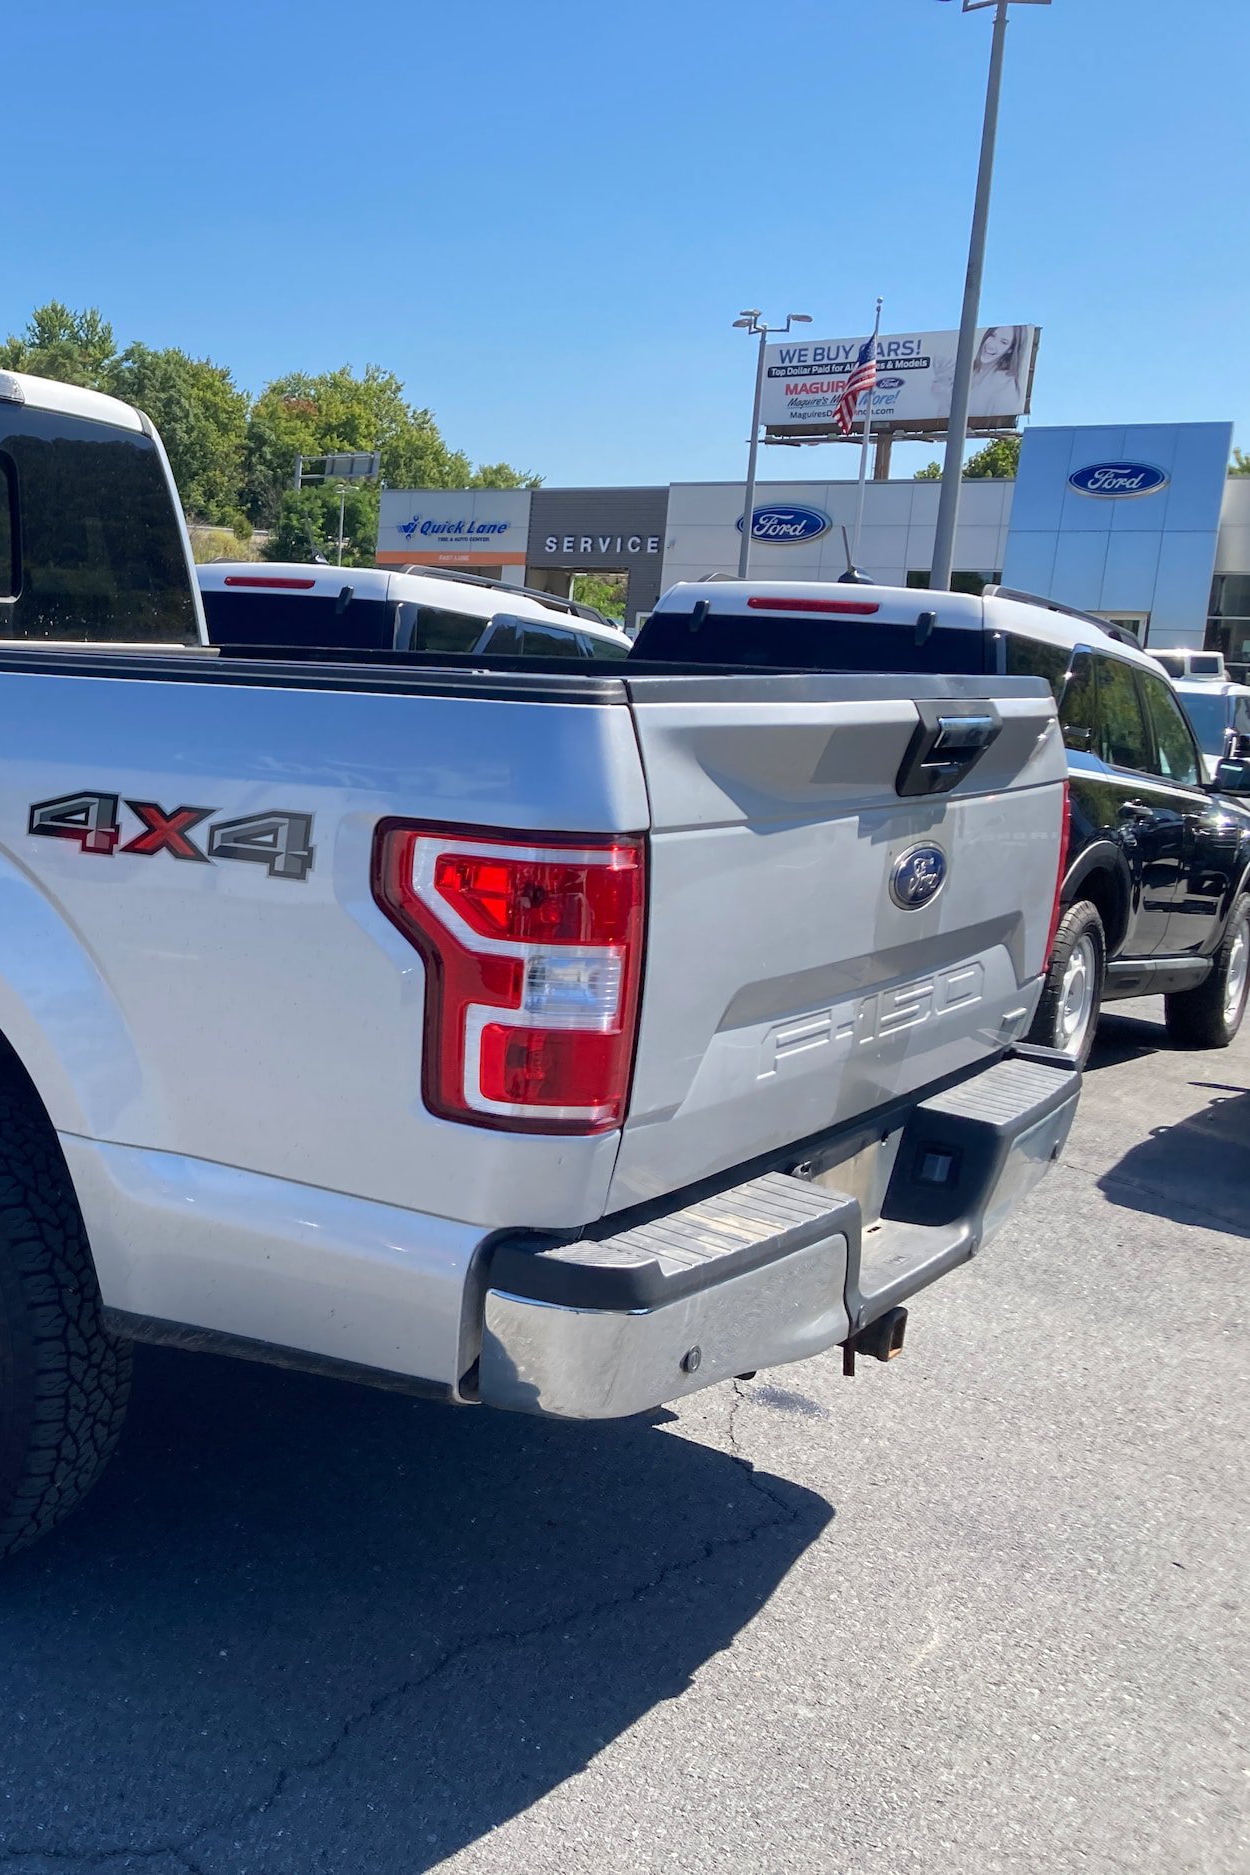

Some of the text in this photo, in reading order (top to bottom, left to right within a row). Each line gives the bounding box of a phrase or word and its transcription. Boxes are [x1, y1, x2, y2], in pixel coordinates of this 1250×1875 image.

[779, 348, 808, 364] WE
[813, 344, 855, 362] BUY
[771, 368, 786, 377] Top
[787, 366, 811, 375] Dollar
[812, 365, 830, 373] Paid
[831, 364, 843, 372] for
[895, 359, 927, 369] Models
[785, 380, 846, 396] MAGUIR
[879, 379, 899, 388] Ford
[787, 396, 828, 409] Maguire's
[1087, 468, 1145, 490] Ford
[420, 520, 508, 536] Quick Lane
[753, 513, 807, 536] Ford
[544, 536, 660, 554] SERVICE
[907, 856, 942, 895] Ford
[755, 960, 986, 1080] F-150
